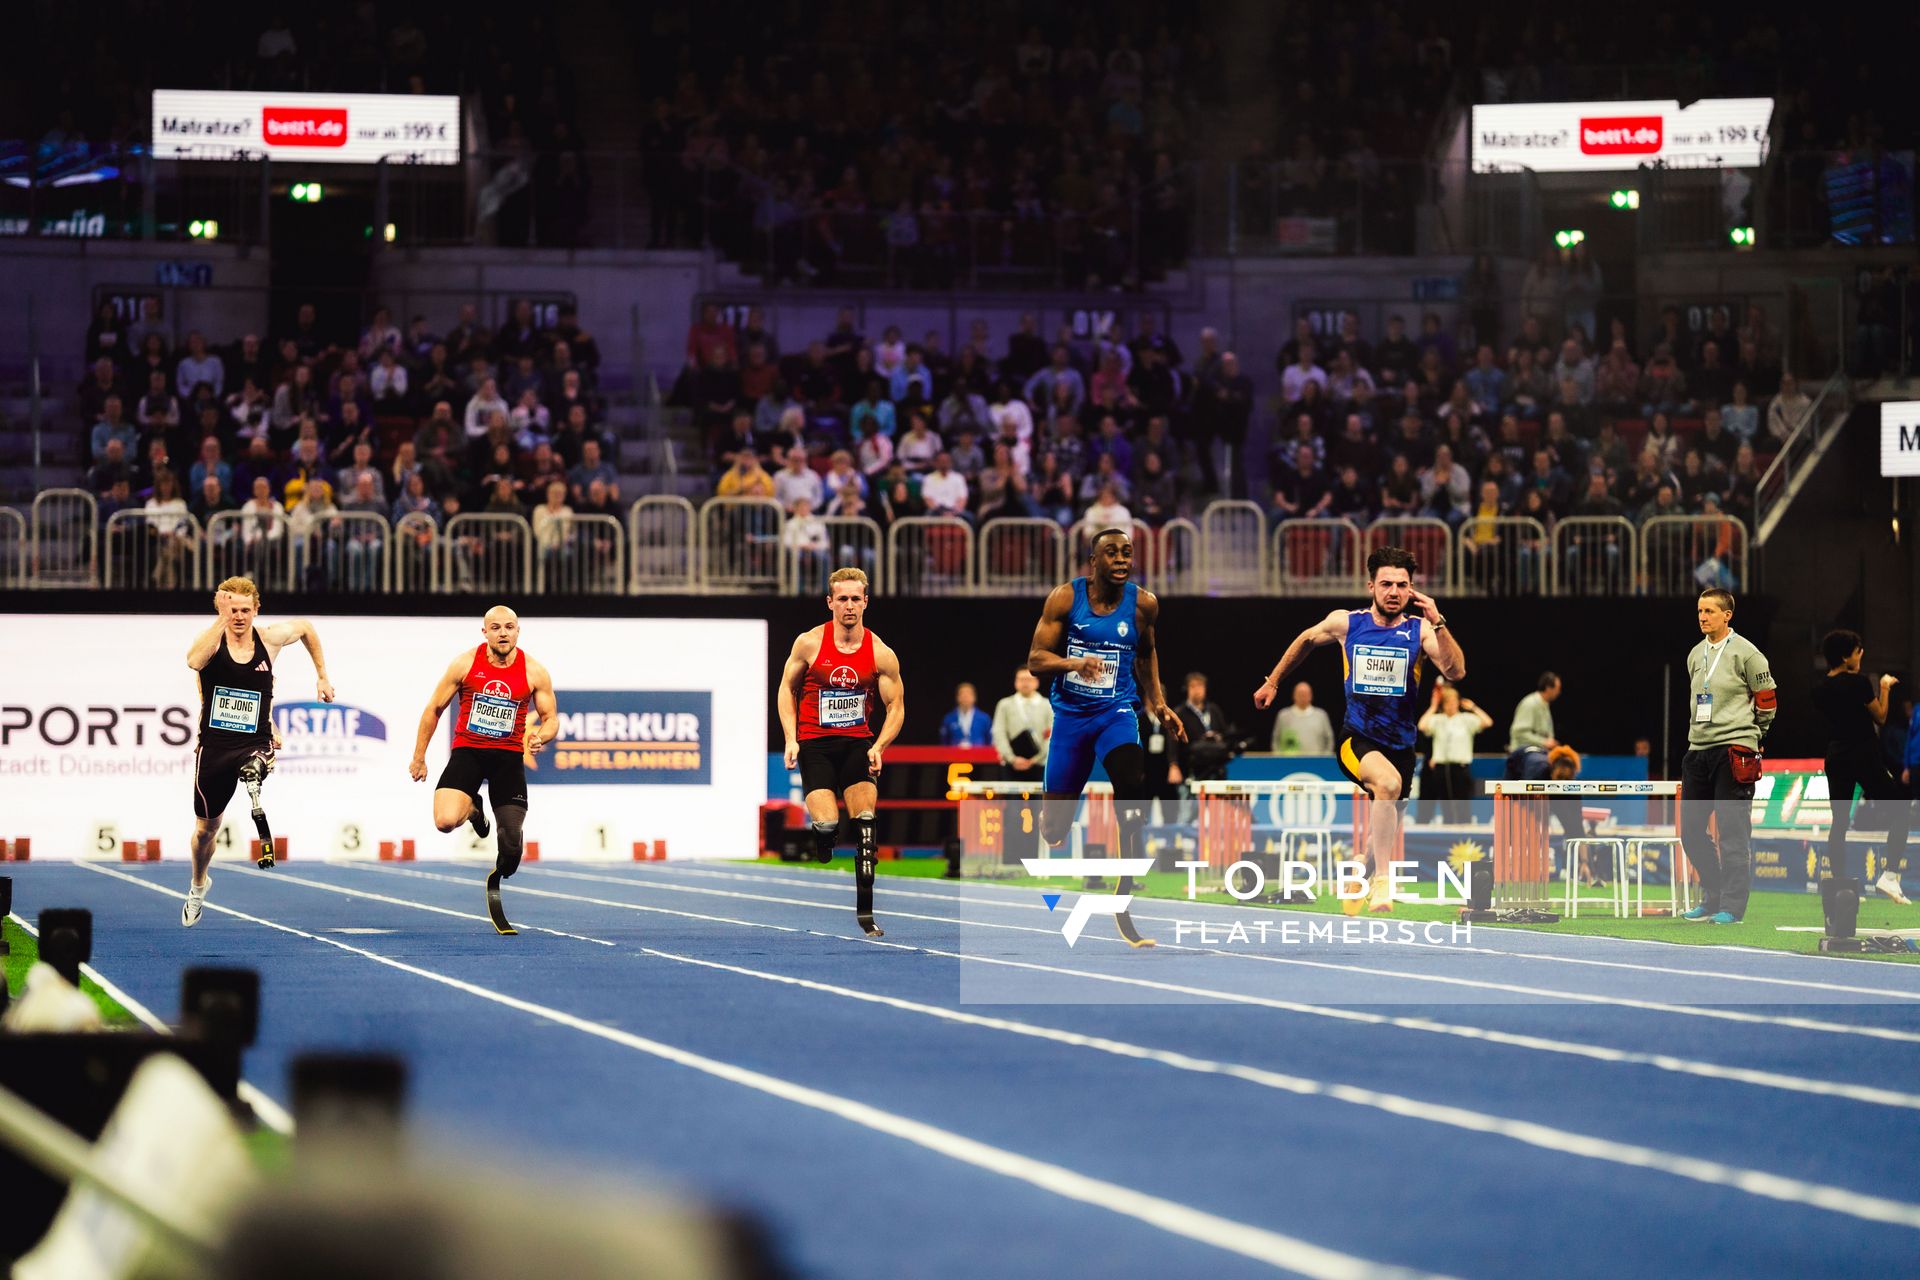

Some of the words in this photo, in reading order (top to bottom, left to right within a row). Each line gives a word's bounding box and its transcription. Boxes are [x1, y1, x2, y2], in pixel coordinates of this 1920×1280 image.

[161, 117, 251, 136] Matratze?
[267, 118, 343, 137] bett1.de
[1482, 129, 1569, 147] Matratze?
[1584, 127, 1659, 145] bett1.de
[1718, 125, 1747, 142] 199
[1366, 658, 1395, 672] SHAW
[832, 676, 856, 684] BAYER
[219, 698, 230, 709] DE
[231, 700, 254, 713] JONG
[828, 698, 859, 710] FLOORS
[220, 711, 240, 720] Allianz
[278, 706, 361, 738] ISTAF
[557, 712, 700, 742] MERKUR
[59, 753, 192, 775] Düsseldorf
[555, 751, 701, 770] SPIELBANKEN
[98, 827, 115, 851] 5
[216, 826, 232, 849] 4
[342, 824, 361, 850] 3
[597, 824, 606, 849] 1
